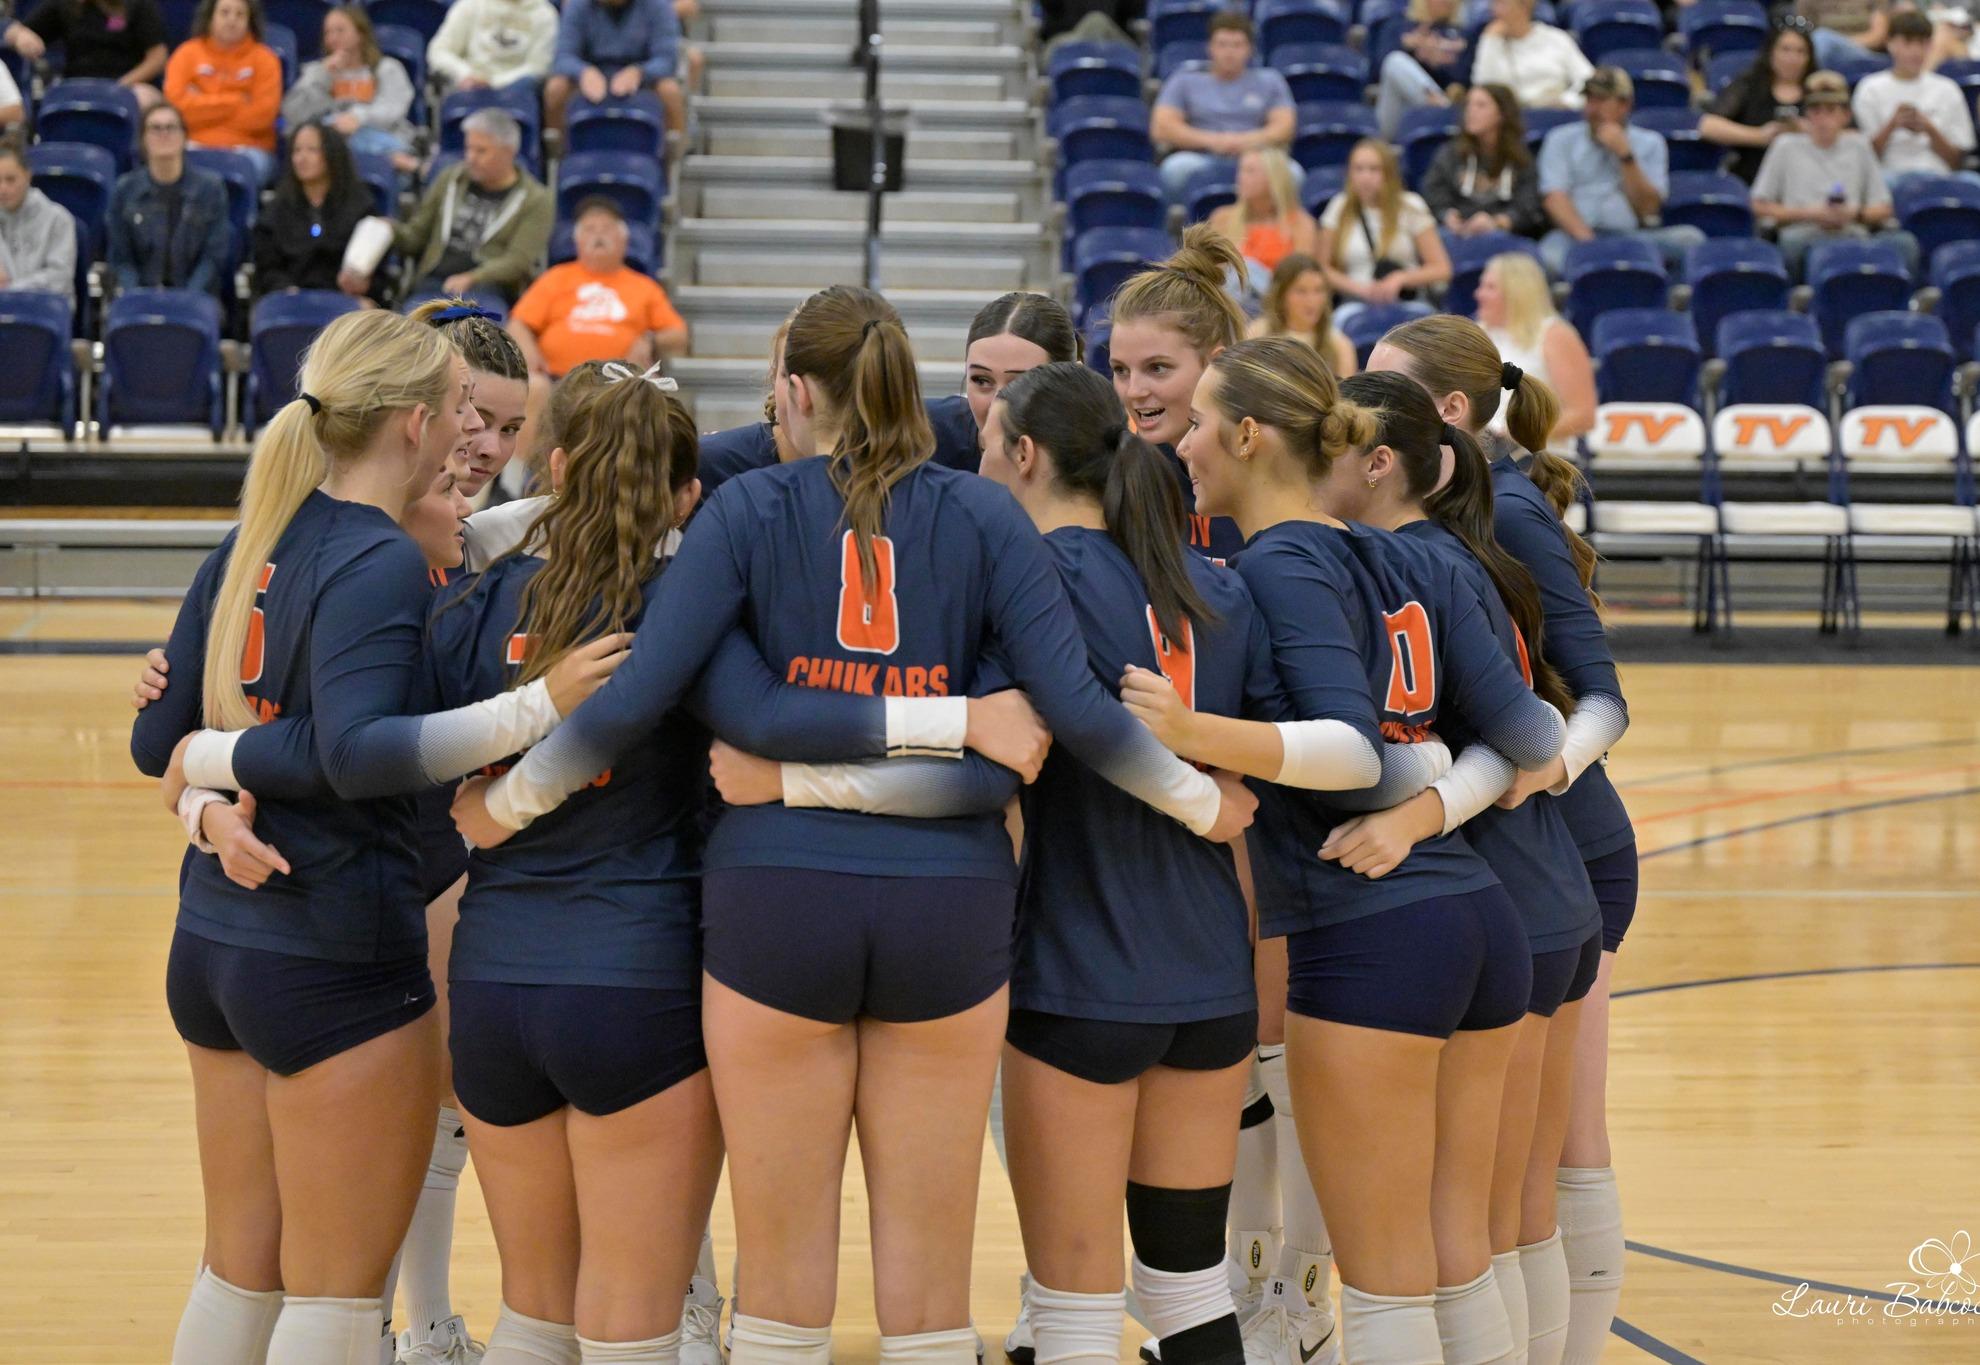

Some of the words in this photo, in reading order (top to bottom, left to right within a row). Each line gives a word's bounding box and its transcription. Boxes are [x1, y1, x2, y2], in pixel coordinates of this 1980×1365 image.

[1606, 412, 1686, 444] TV
[1733, 414, 1811, 447] TV
[1860, 415, 1938, 448] TV
[836, 528, 900, 655] 8
[786, 655, 949, 698] CHUKARS
